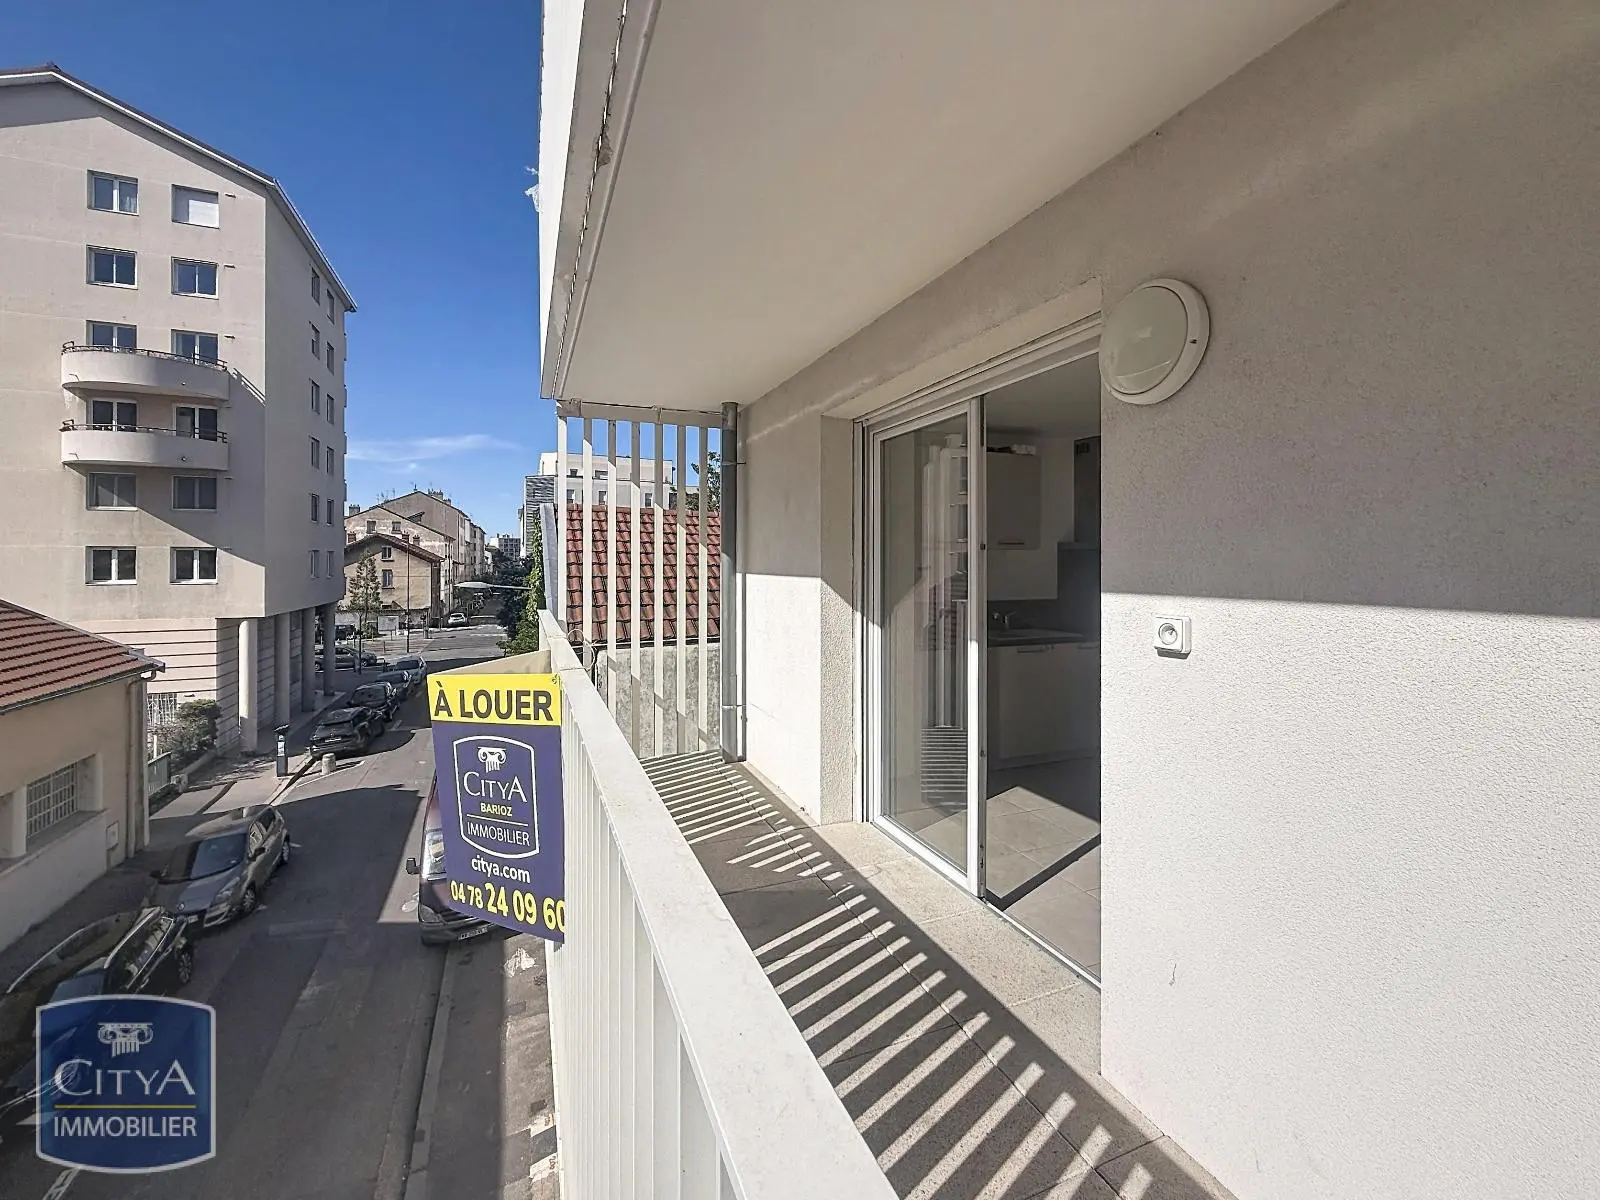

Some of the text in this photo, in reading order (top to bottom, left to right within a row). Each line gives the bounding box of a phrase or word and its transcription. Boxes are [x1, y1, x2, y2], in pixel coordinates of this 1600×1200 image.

[434, 681, 554, 722] À LOUER
[480, 802, 513, 817] BARIOZ
[467, 821, 530, 846] IMMOBILIER
[471, 855, 530, 883] citya.com
[450, 880, 466, 904] 04
[467, 886, 484, 909] 78
[484, 882, 509, 917] 24
[512, 892, 537, 925] 09
